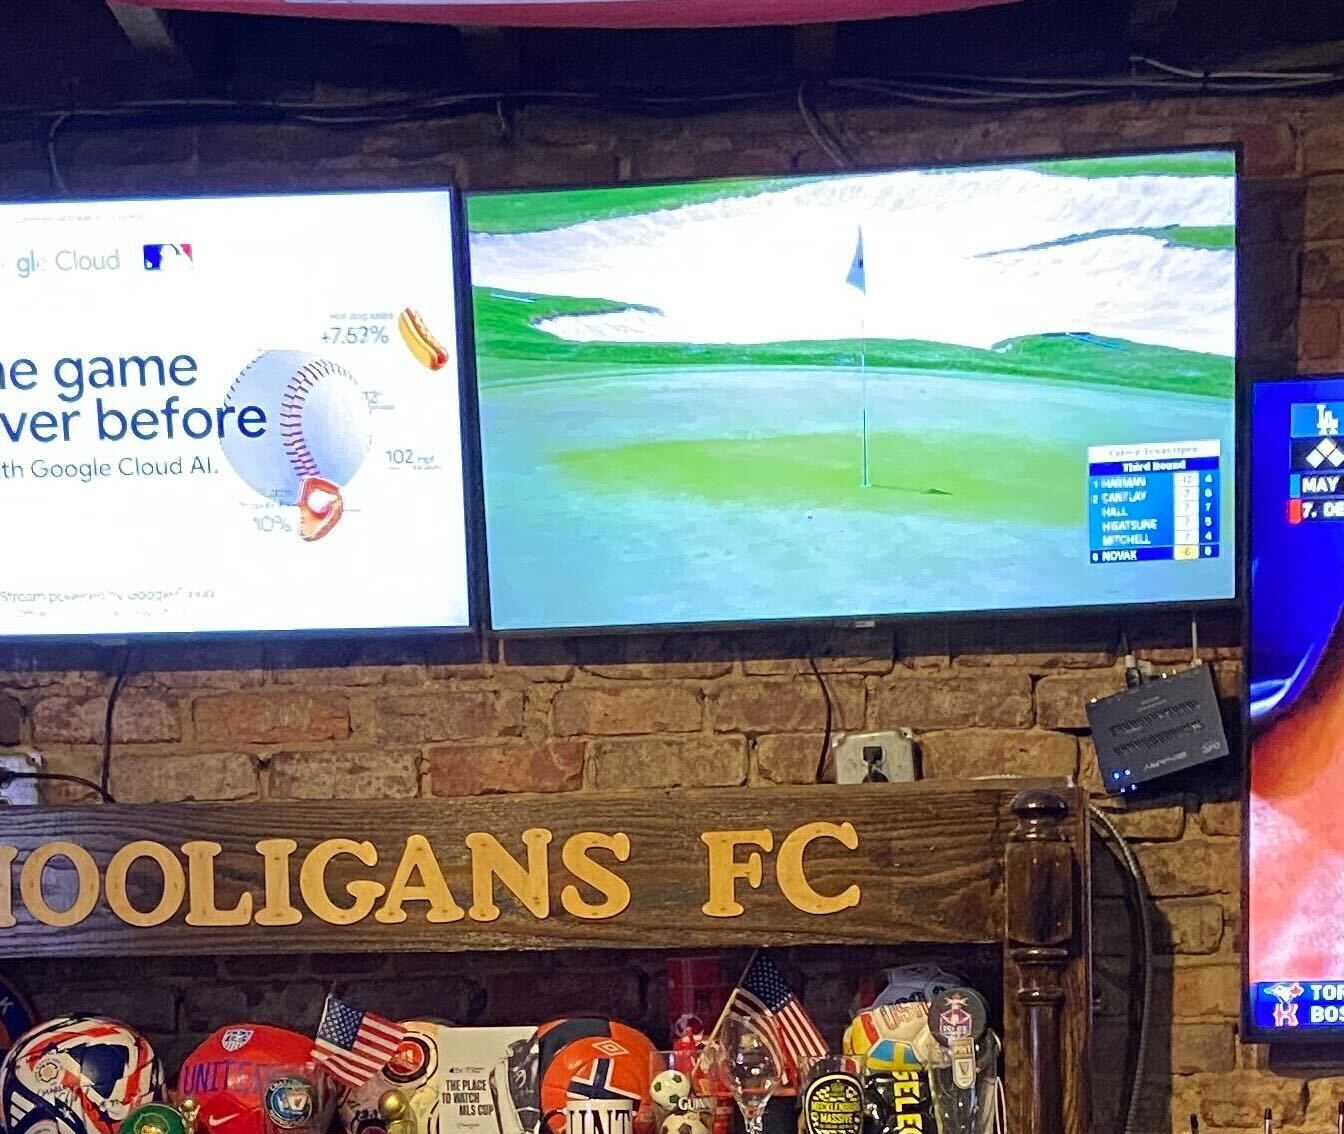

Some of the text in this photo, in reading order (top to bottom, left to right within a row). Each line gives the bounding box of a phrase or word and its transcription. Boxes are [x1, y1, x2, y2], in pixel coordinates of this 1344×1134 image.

[55, 248, 121, 272] Cloud
[54, 352, 199, 403] game
[96, 395, 268, 441] before
[385, 448, 414, 464] 102
[30, 457, 112, 483] Google
[118, 456, 184, 477] Cloud
[190, 455, 220, 475] AI.
[1302, 477, 1340, 493] MAY
[1301, 502, 1318, 518] 7.
[701, 821, 859, 919] FC
[445, 1079, 487, 1091] THE PLACE
[442, 1092, 480, 1103] TO WATCH
[459, 1104, 476, 1116] MLS
